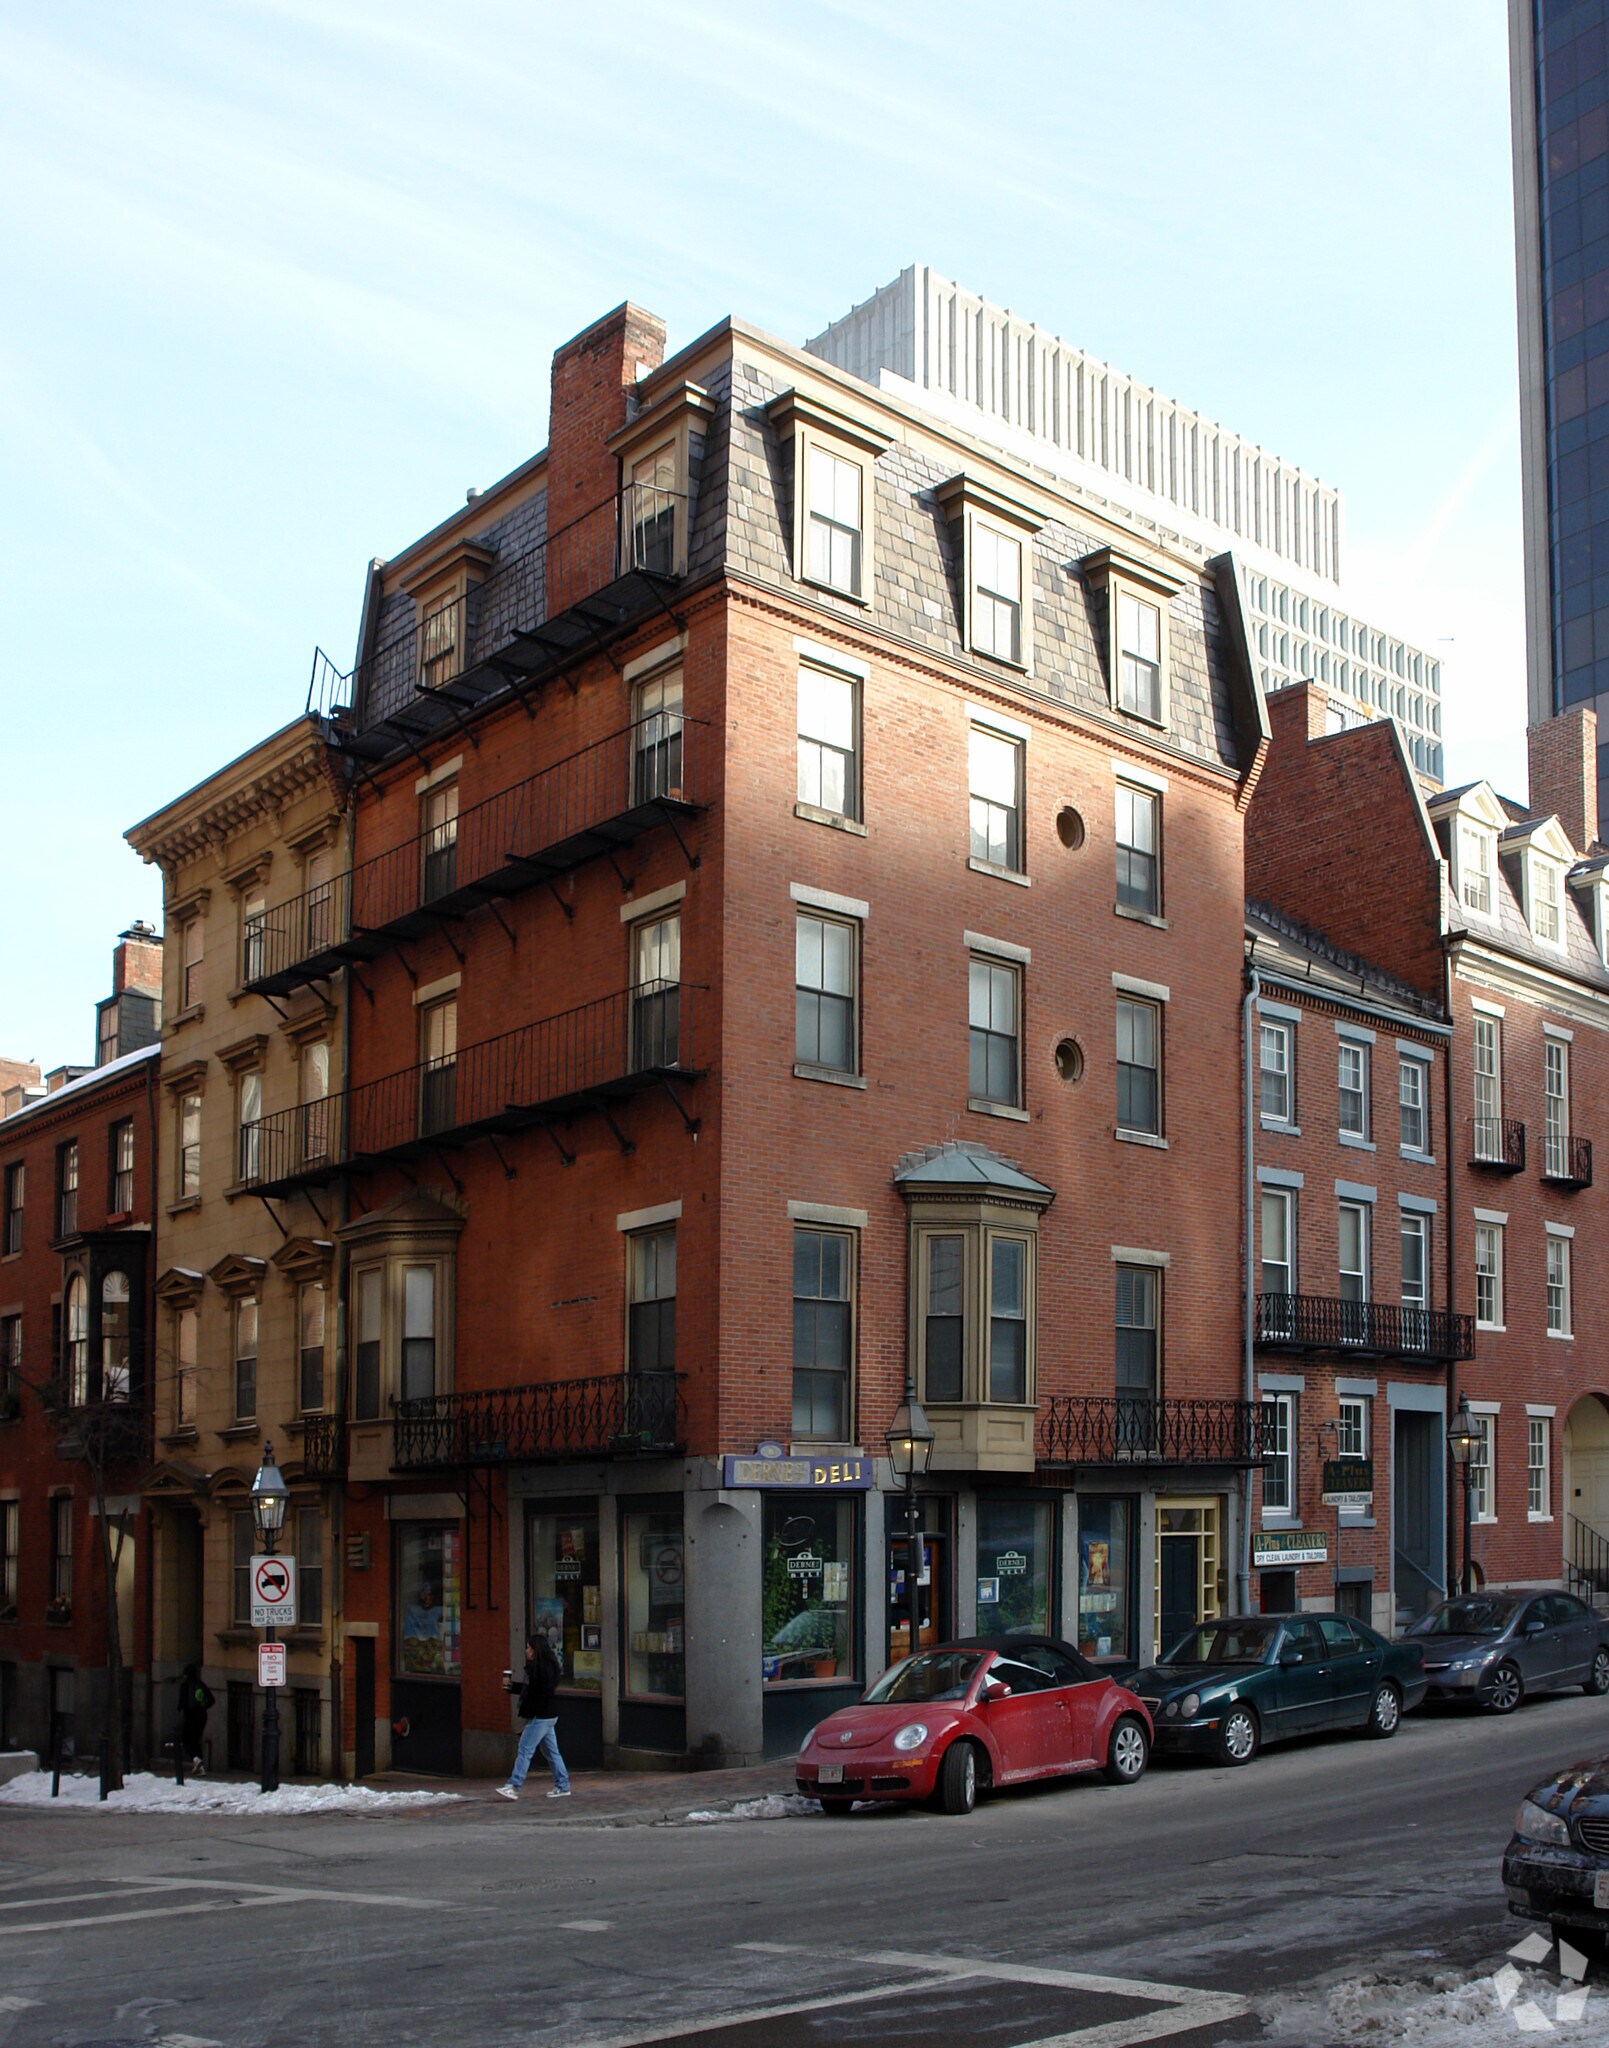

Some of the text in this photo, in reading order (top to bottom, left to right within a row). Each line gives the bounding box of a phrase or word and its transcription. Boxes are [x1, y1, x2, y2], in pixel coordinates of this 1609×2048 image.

[740, 1462, 793, 1482] DERNE
[814, 1461, 861, 1484] DELI
[1287, 1533, 1326, 1549] CLEANERS
[254, 1607, 292, 1616] NO TRUCKS
